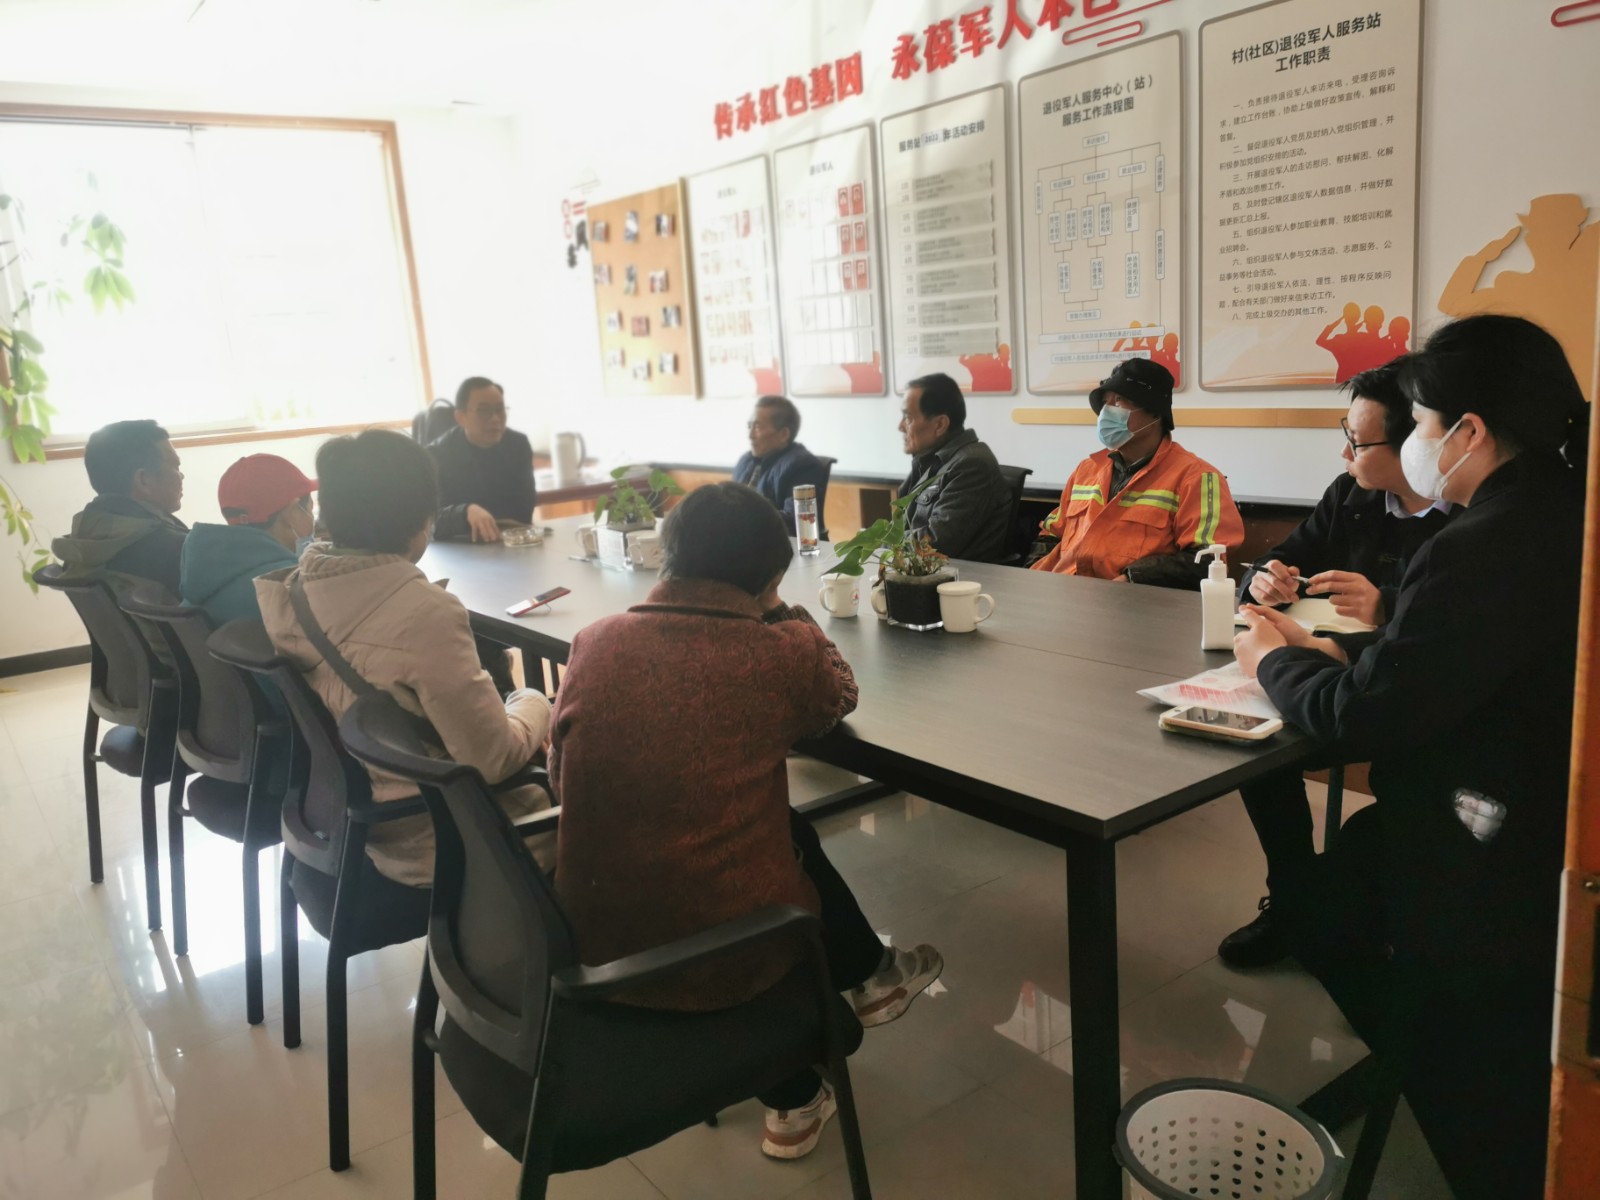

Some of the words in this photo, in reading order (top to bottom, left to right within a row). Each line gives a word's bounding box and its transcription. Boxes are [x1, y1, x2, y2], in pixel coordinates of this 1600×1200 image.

[1232, 11, 1382, 64] 村(社区)退役军人服务站
[1275, 46, 1331, 73] 工作职责
[713, 51, 864, 140] 传承红色基因
[1062, 96, 1134, 127] 服务工作流程图
